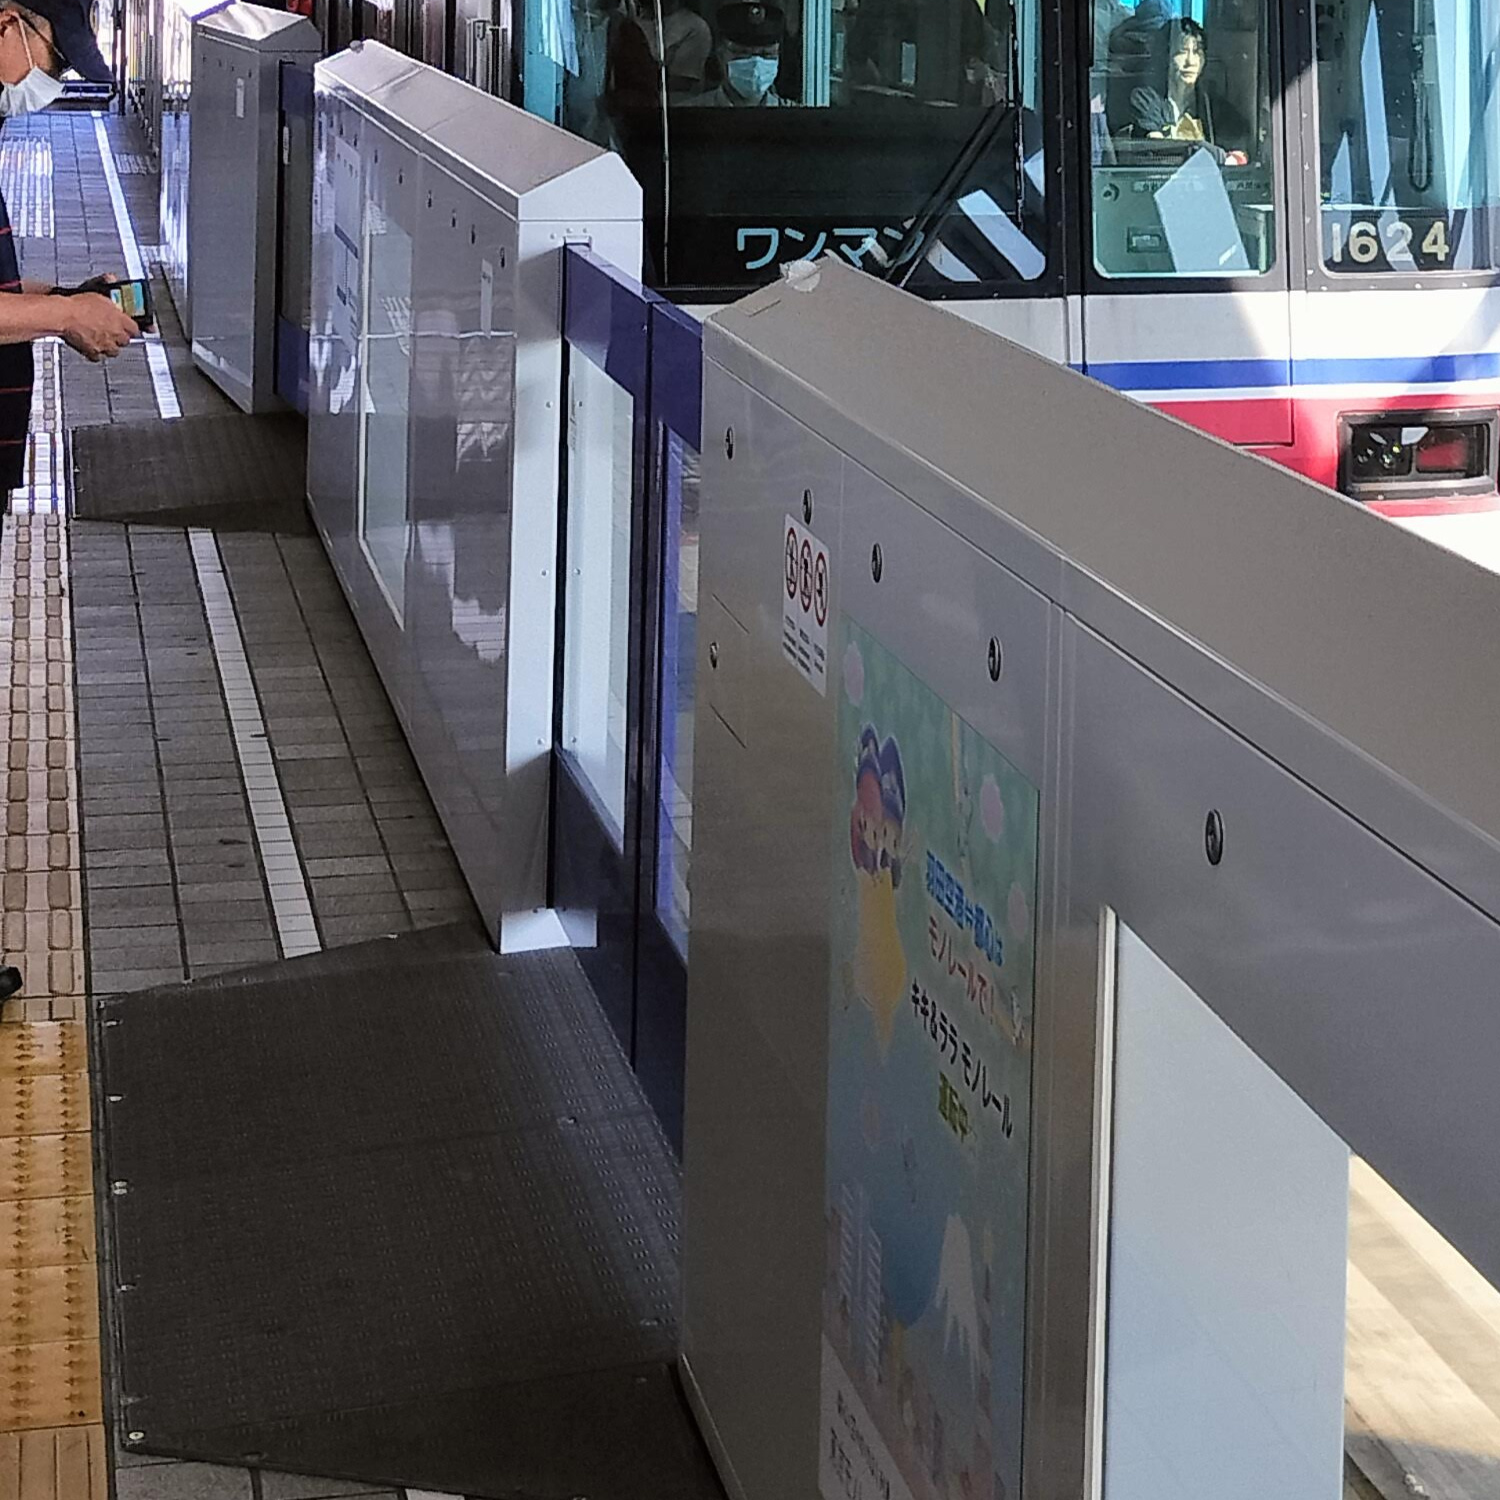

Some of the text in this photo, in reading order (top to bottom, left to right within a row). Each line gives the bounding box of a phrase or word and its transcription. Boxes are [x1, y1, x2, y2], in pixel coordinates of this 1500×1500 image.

[737, 227, 925, 269] ワンマン
[1332, 221, 1449, 263] 1624
